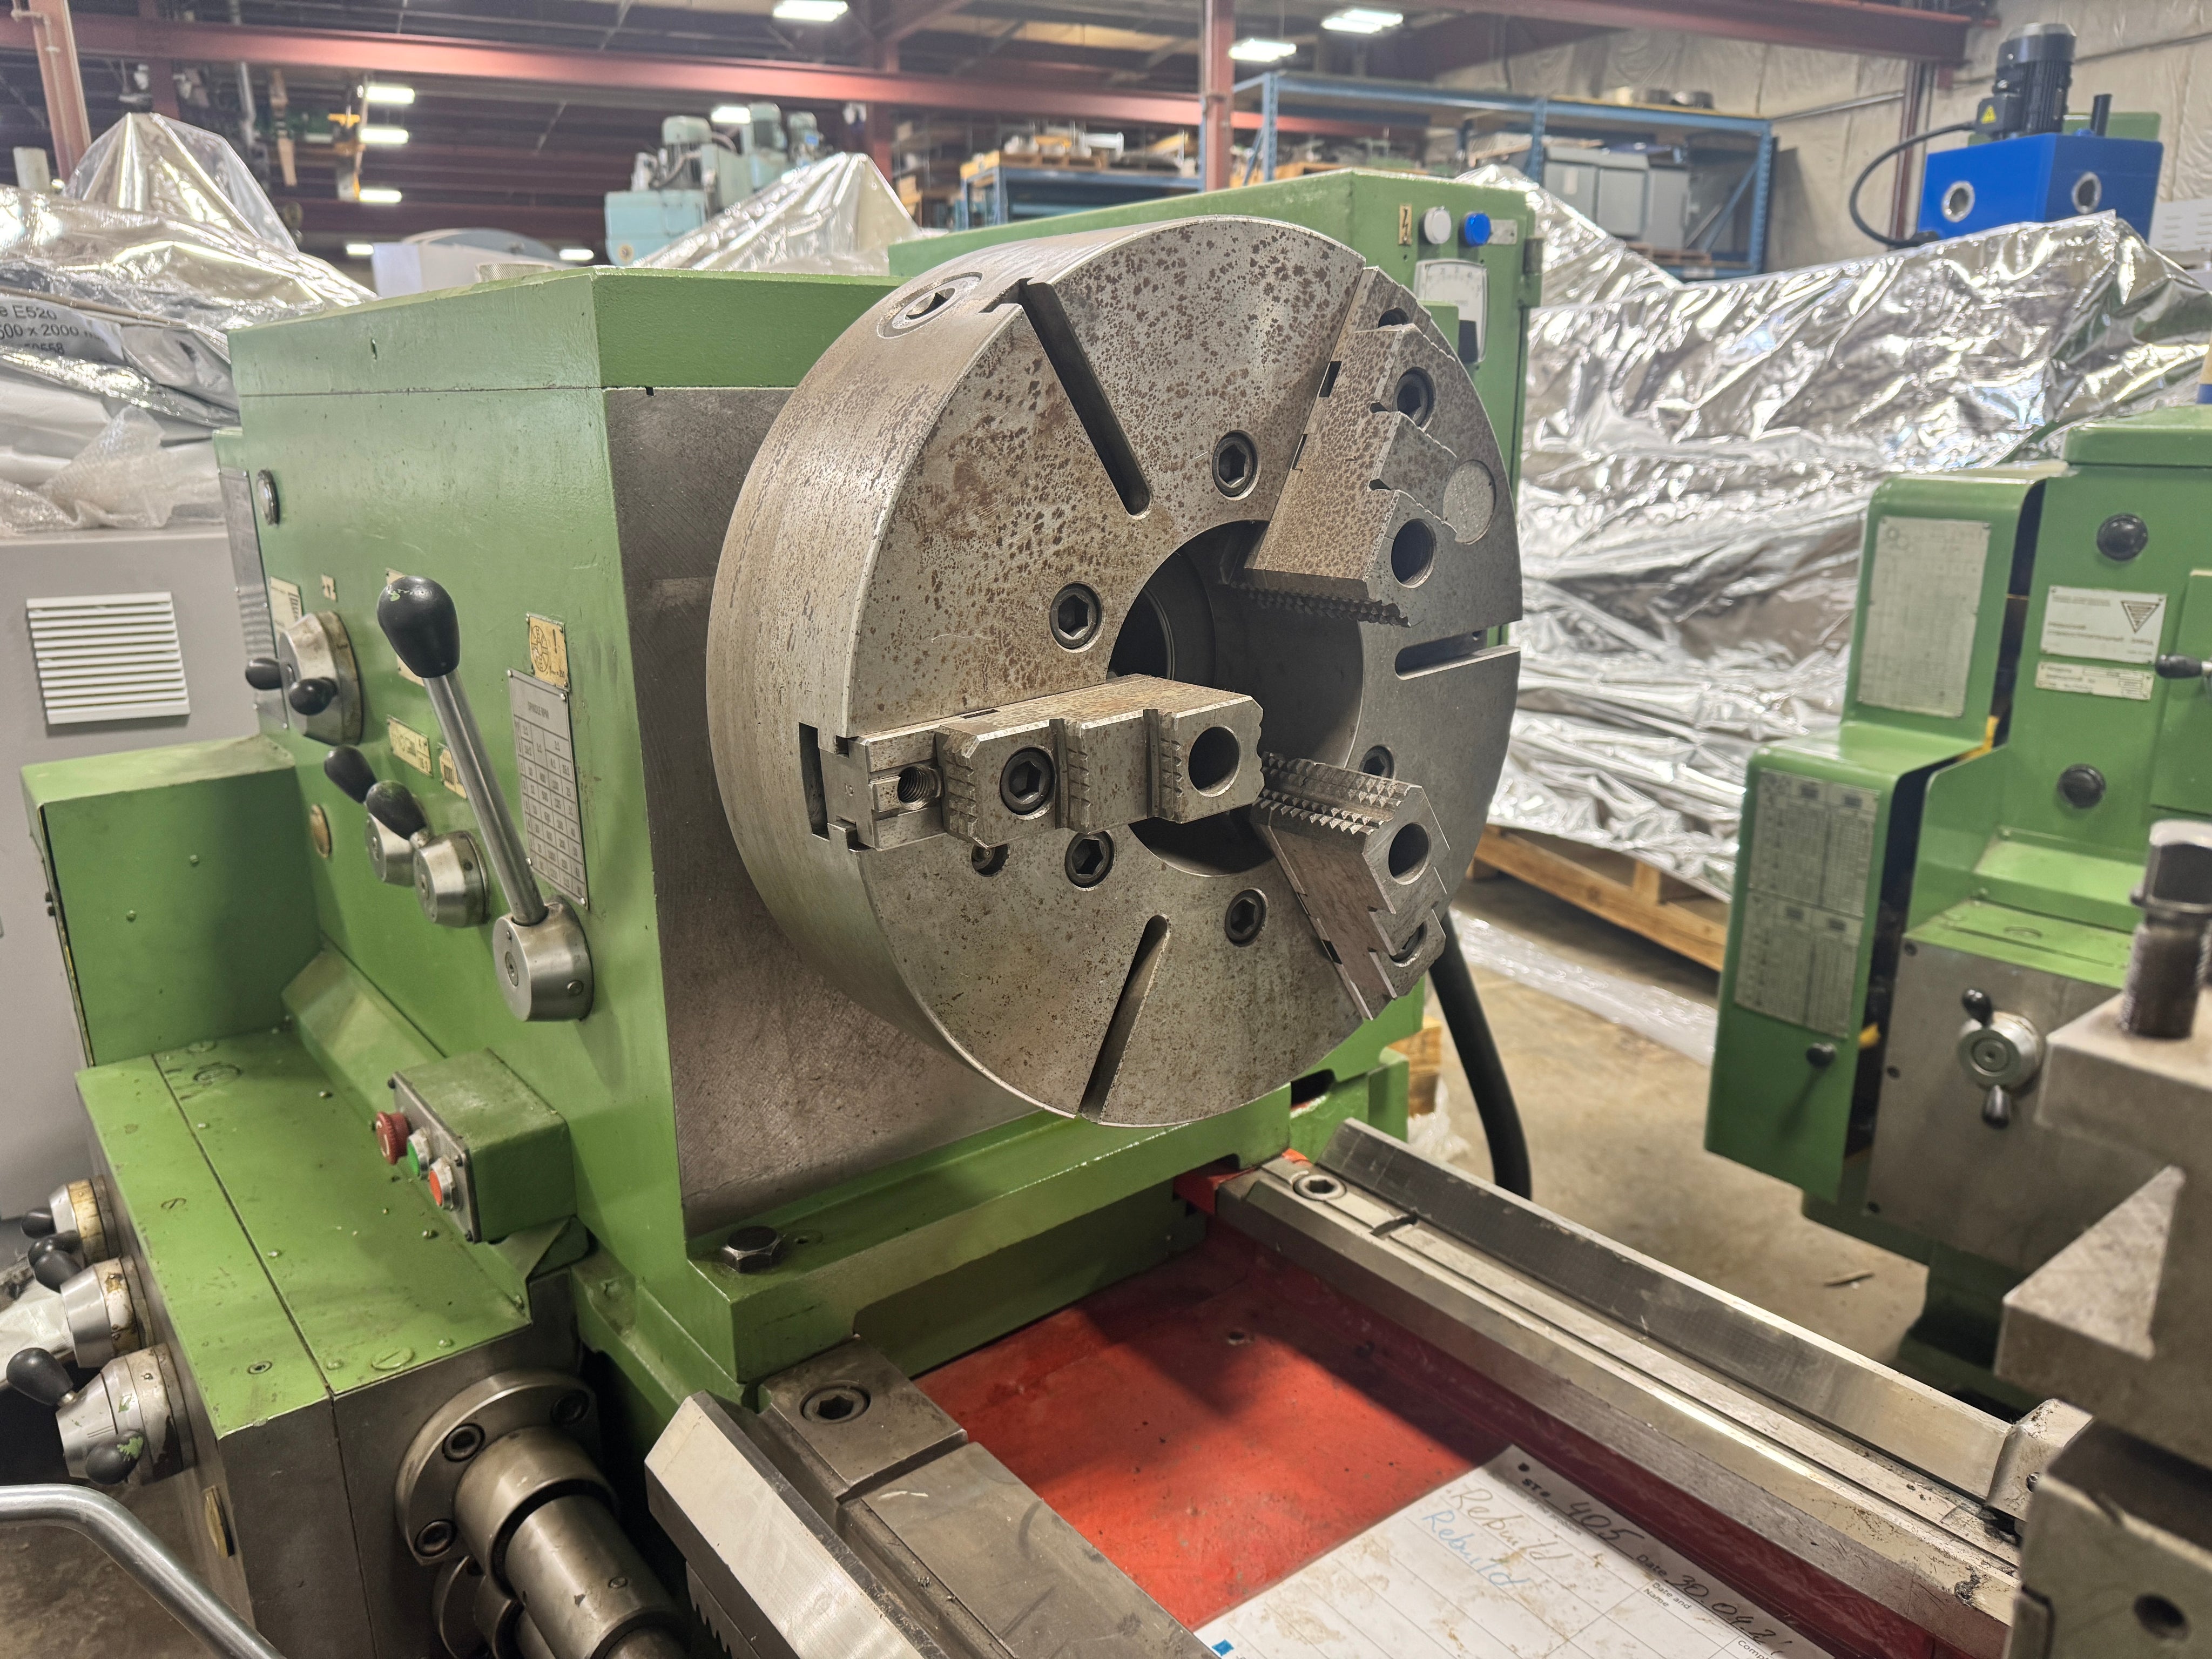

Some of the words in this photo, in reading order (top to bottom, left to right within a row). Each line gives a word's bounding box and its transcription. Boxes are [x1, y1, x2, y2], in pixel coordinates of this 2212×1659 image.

[12, 304, 57, 320] E520
[41, 323, 79, 336] 2000
[1450, 1483, 1573, 1560] Rebuild
[1422, 1510, 1532, 1586] Rebuild
[1636, 1554, 1668, 1578] Date
[1643, 1588, 1669, 1607] Name
[1652, 1582, 1672, 1597] Date
[1673, 1595, 1692, 1609] and
